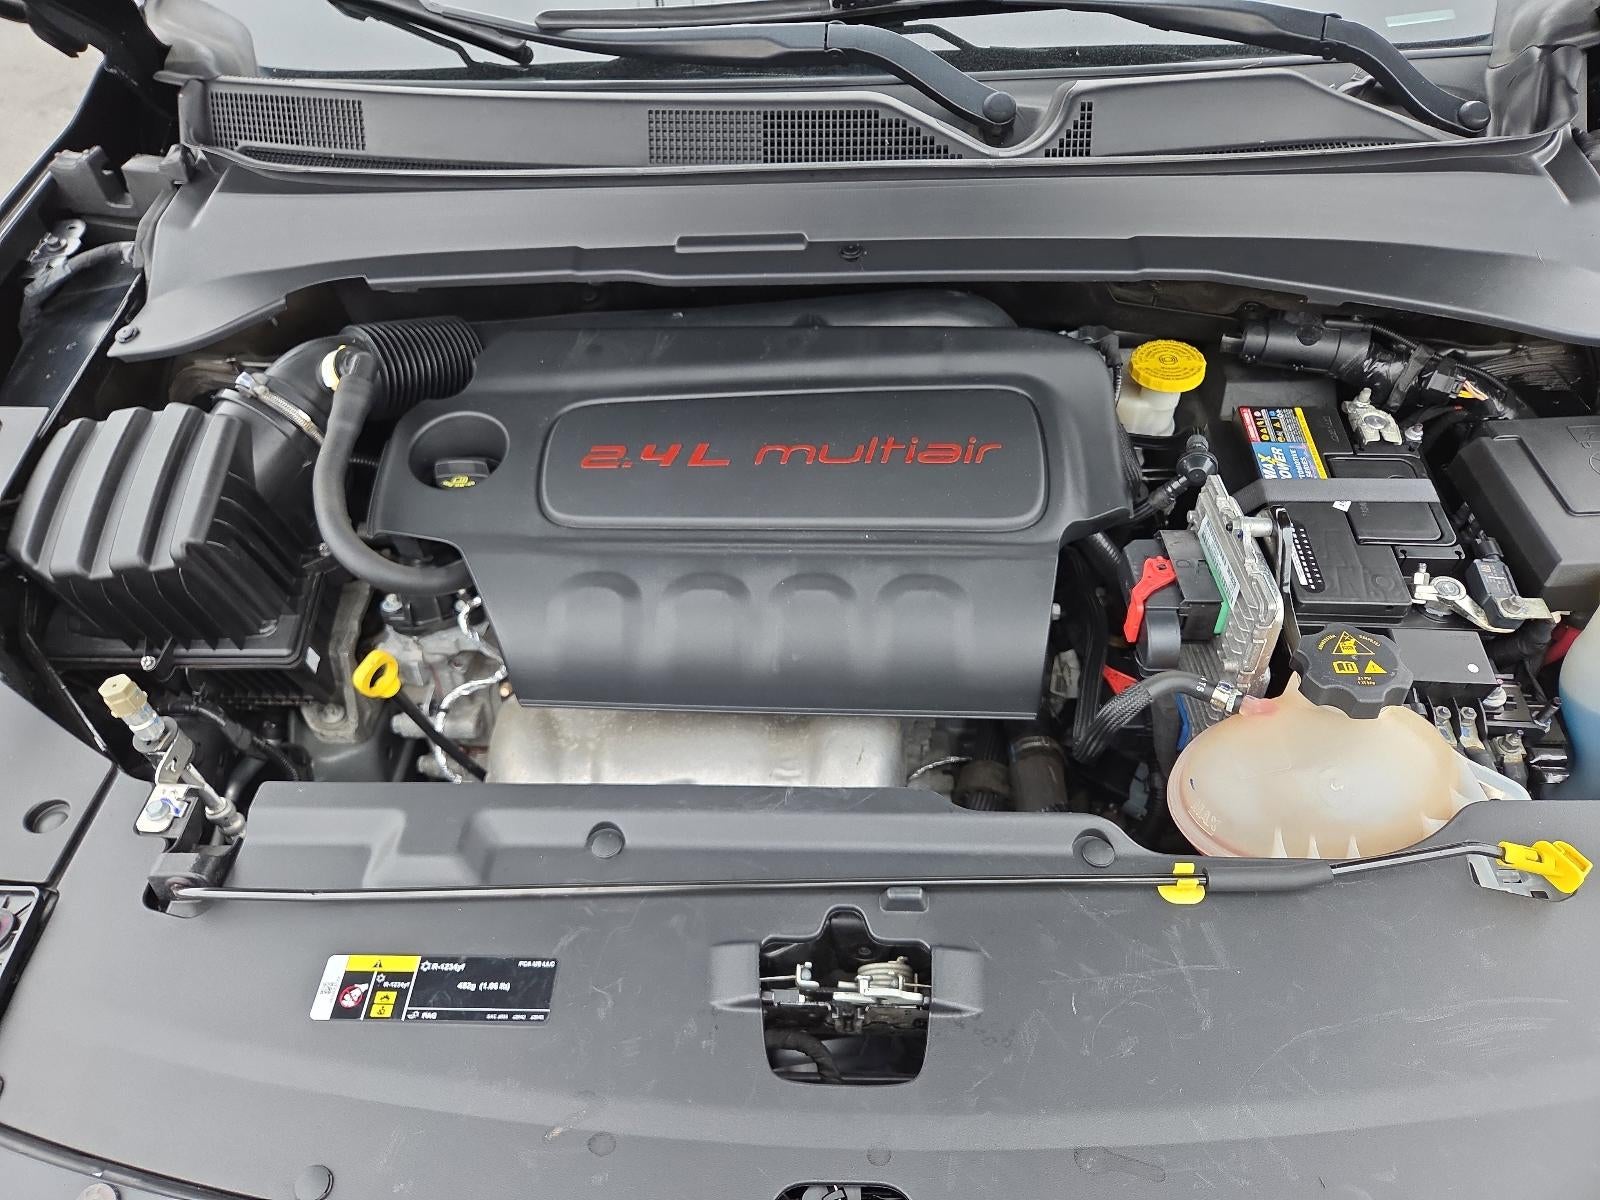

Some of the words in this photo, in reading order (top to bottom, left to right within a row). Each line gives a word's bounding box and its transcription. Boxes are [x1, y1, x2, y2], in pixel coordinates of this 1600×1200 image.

[580, 442, 731, 469] 2.4L
[754, 436, 1002, 465] multiair
[1258, 453, 1277, 479] MAX
[1271, 447, 1292, 479] OWER
[1290, 447, 1306, 479] TOMOTIVE
